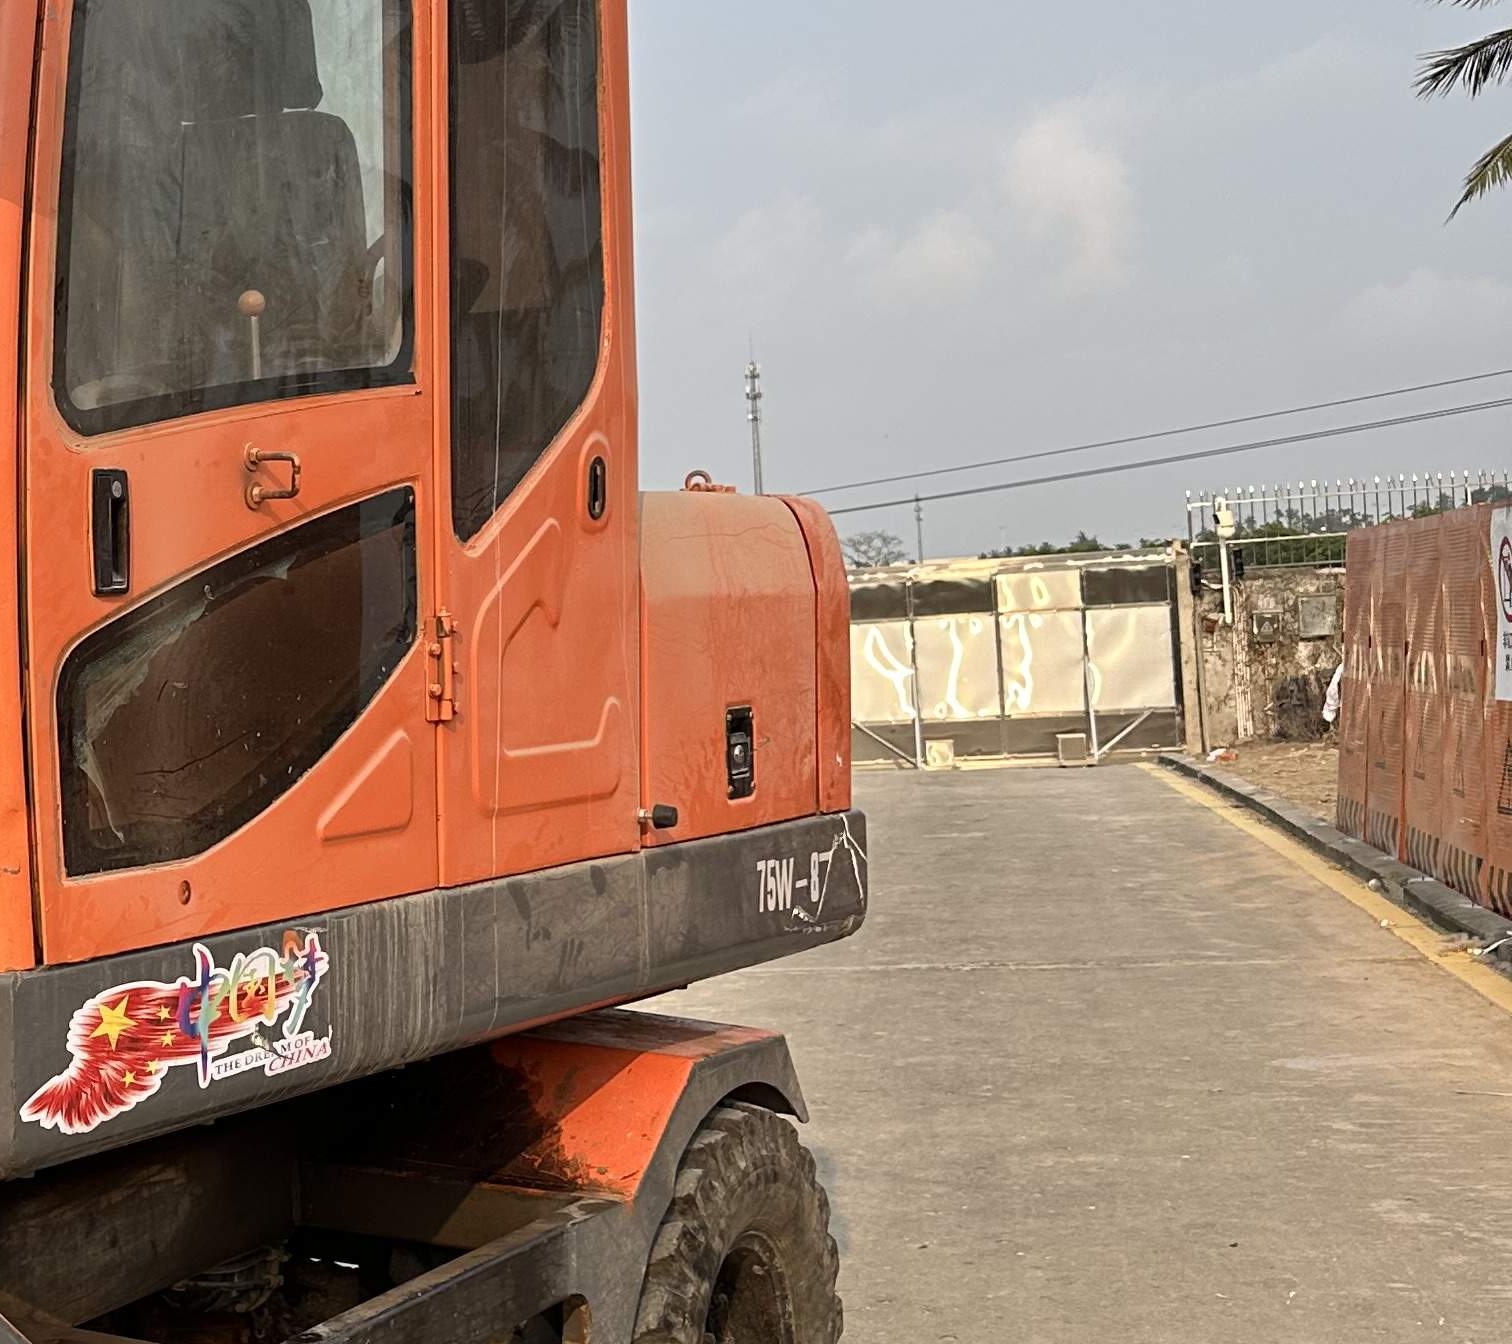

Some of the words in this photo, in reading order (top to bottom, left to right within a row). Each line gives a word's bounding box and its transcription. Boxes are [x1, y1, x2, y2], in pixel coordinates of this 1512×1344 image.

[215, 1060, 242, 1075] THE
[294, 1037, 312, 1049] OF
[268, 1041, 328, 1072] CHINA
